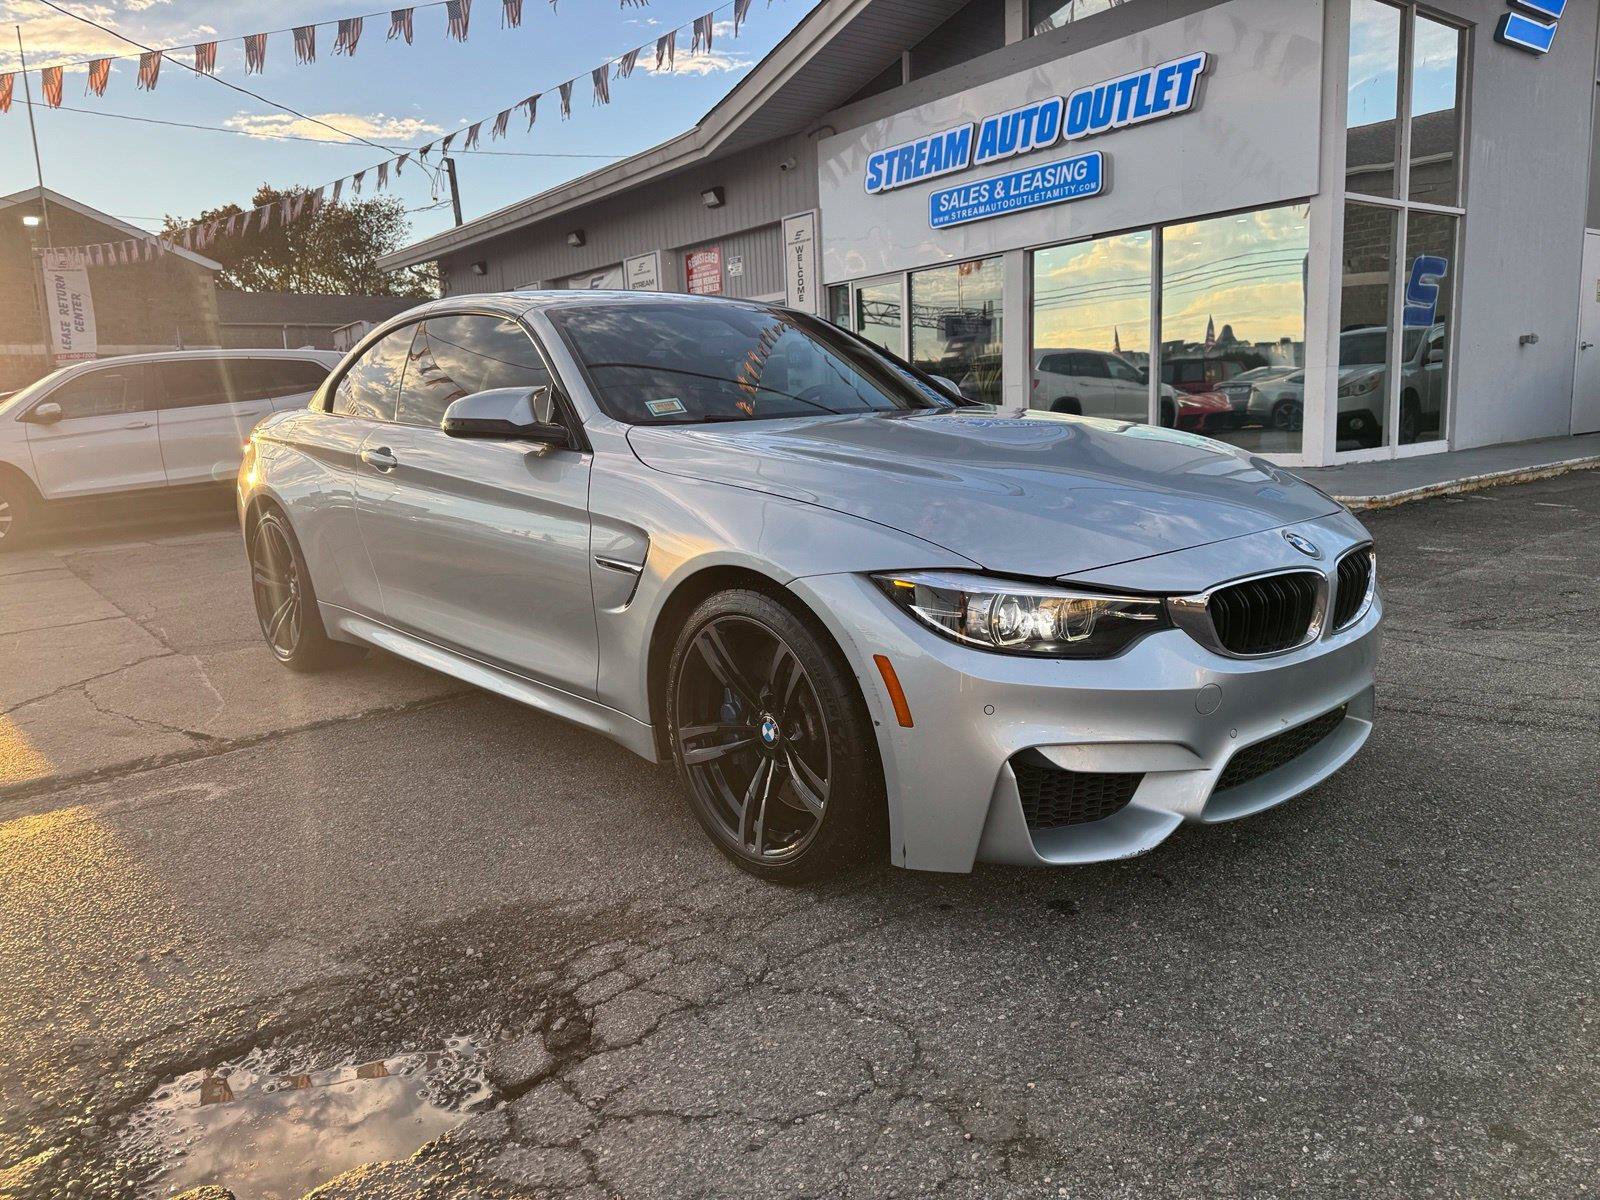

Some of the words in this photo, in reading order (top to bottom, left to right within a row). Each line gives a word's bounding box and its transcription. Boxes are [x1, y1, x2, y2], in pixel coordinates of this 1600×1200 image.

[867, 124, 972, 189] STREAM
[976, 100, 1060, 161] AUTO
[1067, 58, 1202, 136] OUTLET
[939, 184, 990, 212] SALES
[994, 181, 1005, 198] &
[1010, 160, 1088, 196] LEASING
[632, 279, 654, 289] STREAM
[795, 245, 805, 302] WELCOME
[55, 275, 69, 316] RETURN
[72, 293, 85, 332] CENTER
[61, 321, 72, 350] LEASE
